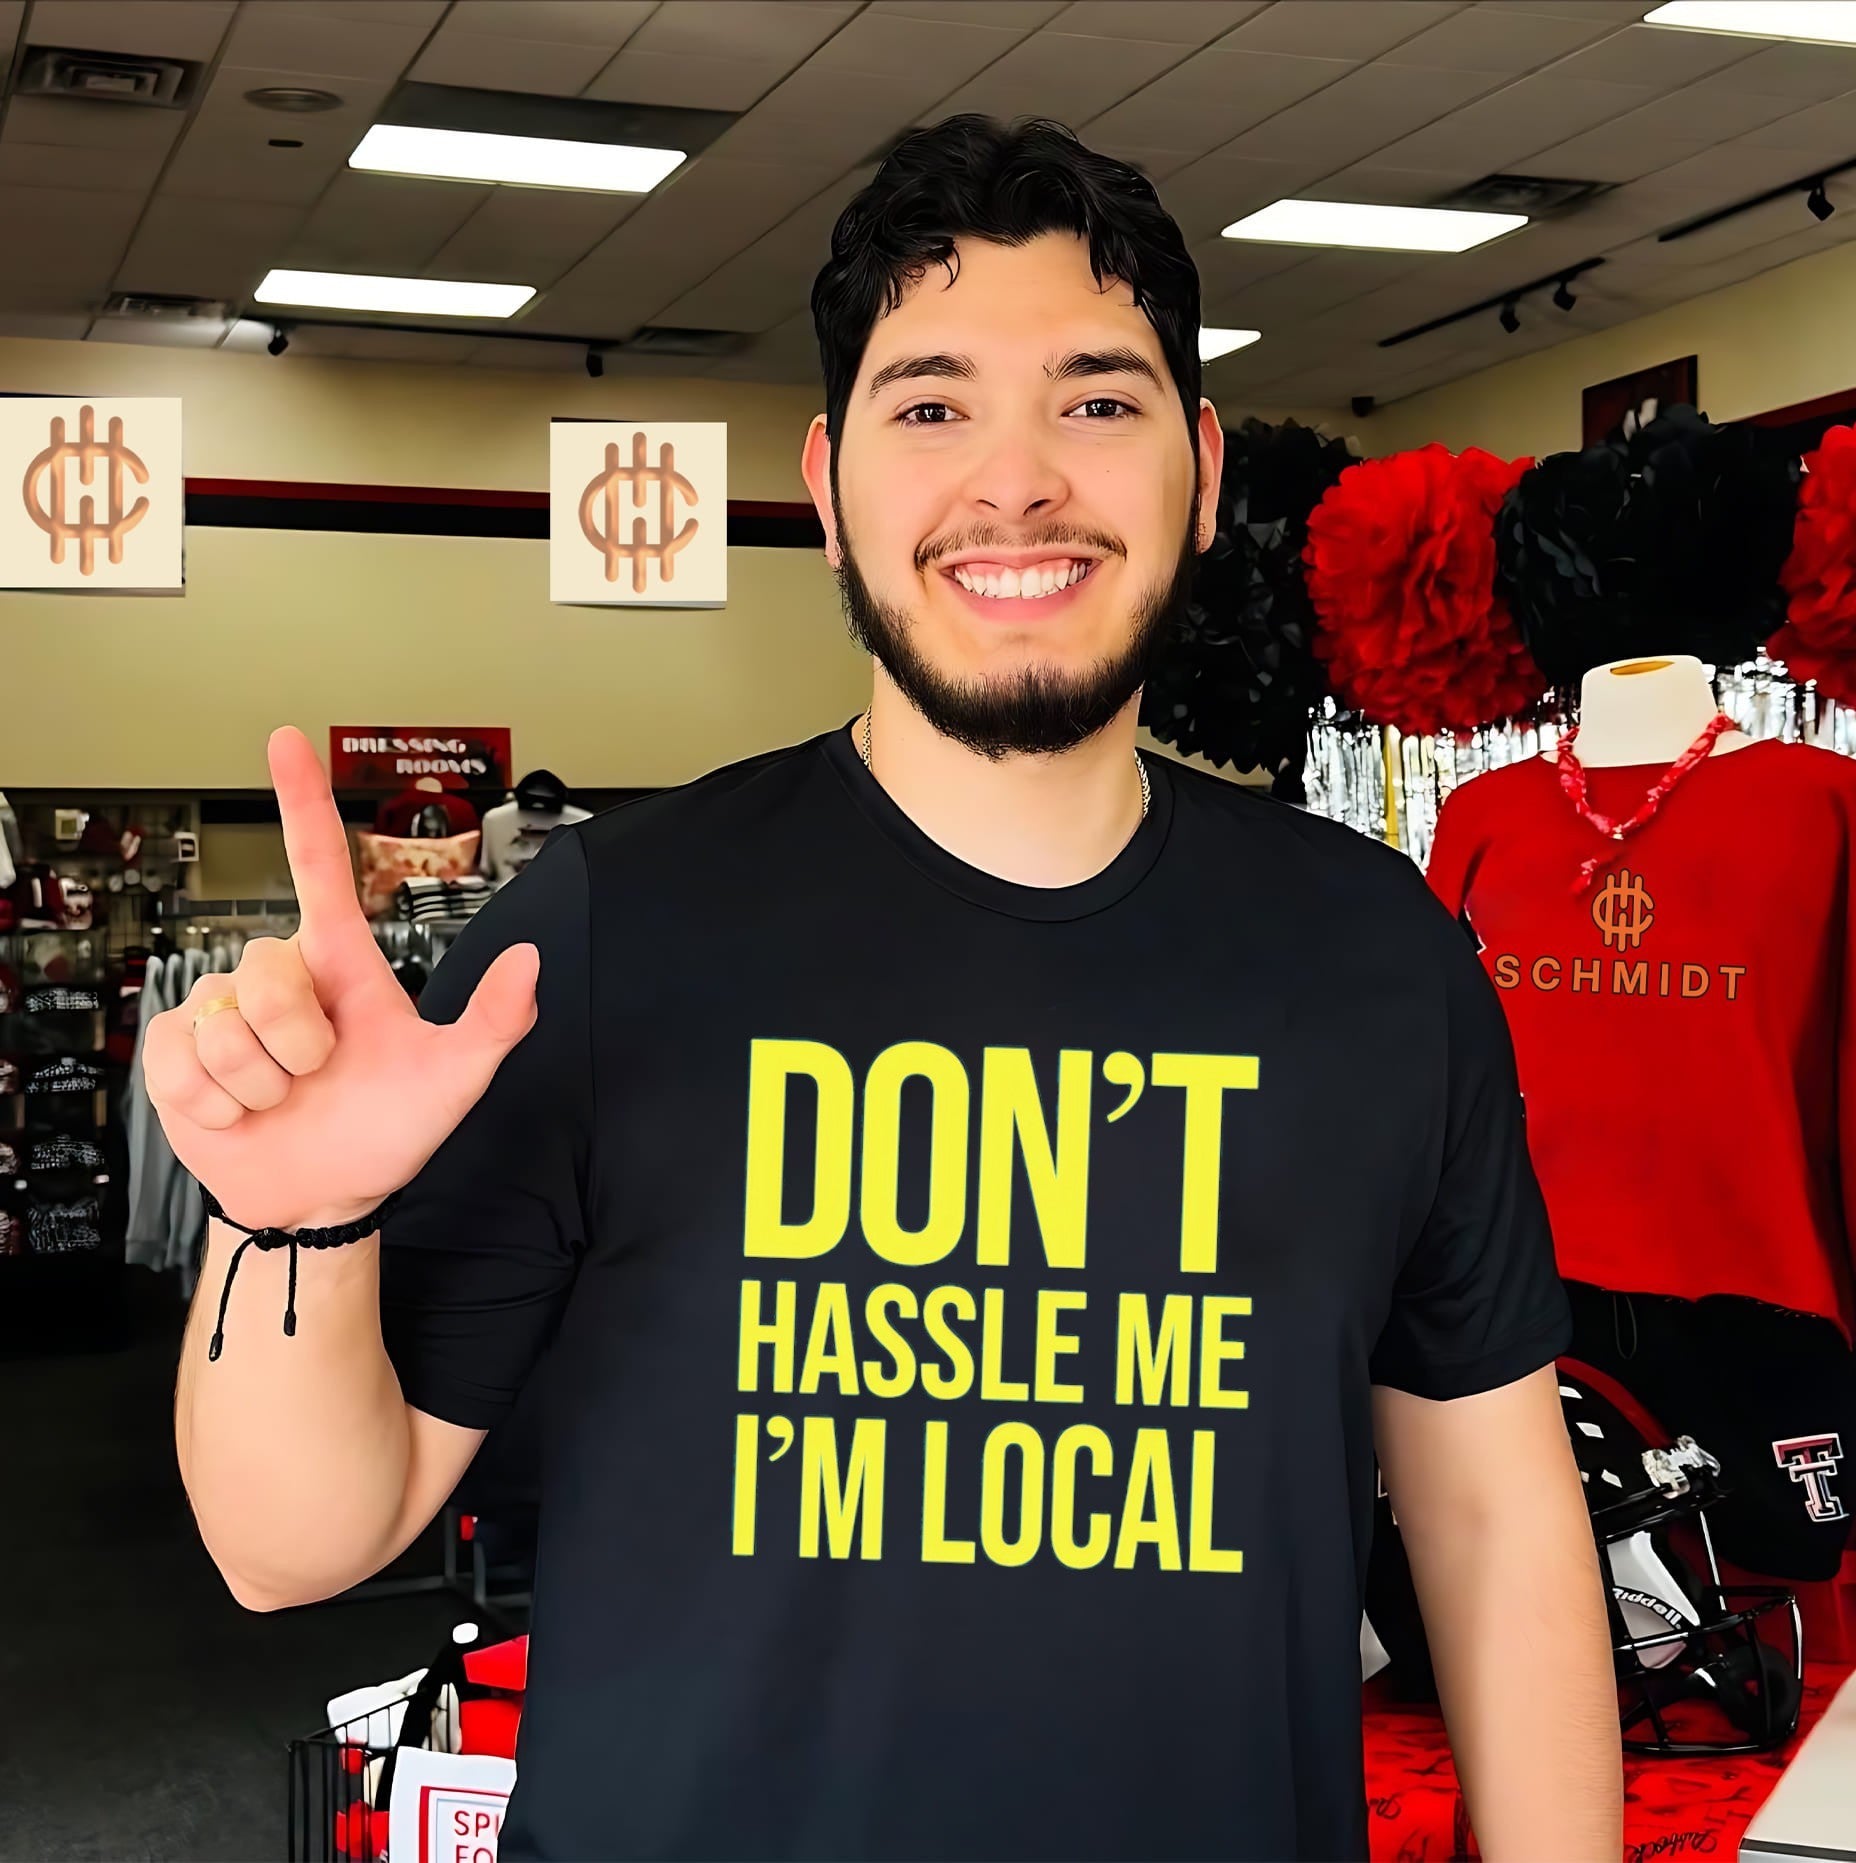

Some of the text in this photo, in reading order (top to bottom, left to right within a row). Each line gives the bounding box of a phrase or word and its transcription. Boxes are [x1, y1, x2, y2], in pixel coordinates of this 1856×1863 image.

[341, 737, 467, 754] DRESSING
[395, 758, 487, 775] ROOMS
[1494, 954, 1747, 1001] SCHMIDT
[744, 1039, 1260, 1274] DON'T
[737, 1280, 1253, 1410] HASSLE ME
[732, 1414, 1244, 1574] I'M LOCAL
